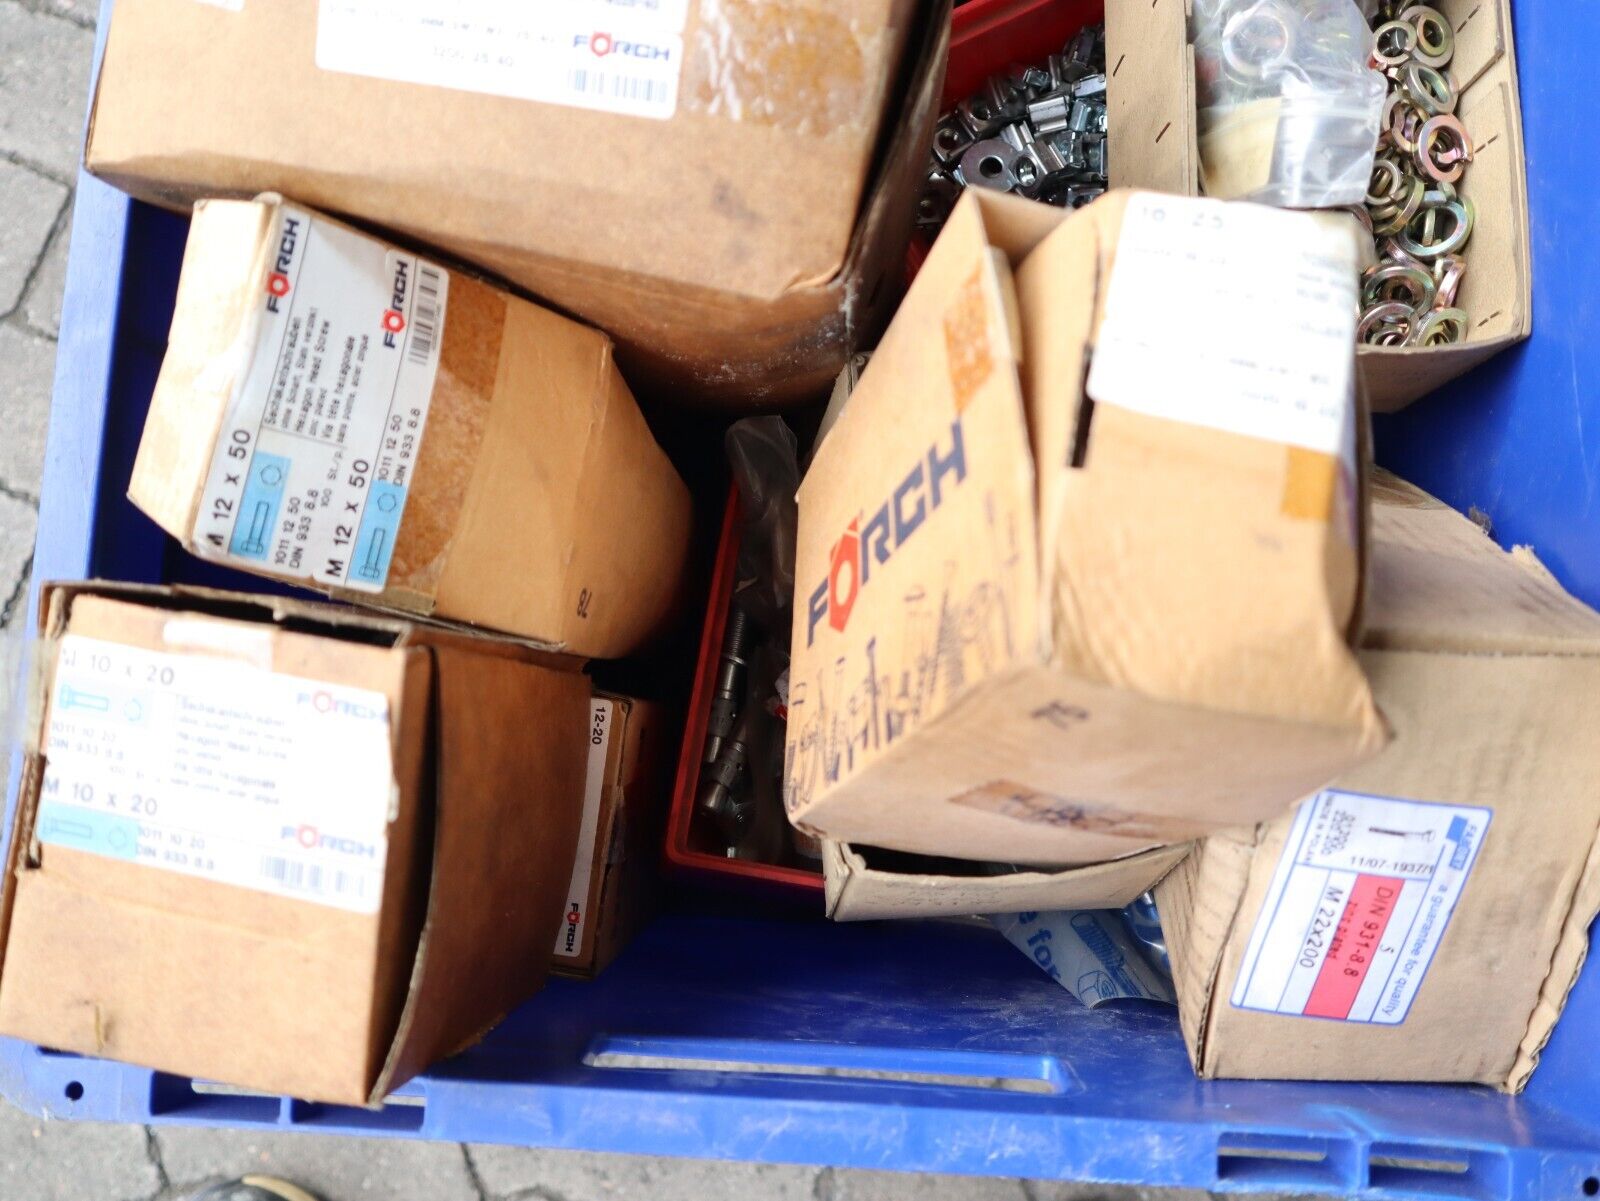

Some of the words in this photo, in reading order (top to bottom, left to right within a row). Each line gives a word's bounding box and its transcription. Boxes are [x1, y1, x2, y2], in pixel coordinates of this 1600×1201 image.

[390, 415, 402, 432] 50
[213, 498, 233, 519] 12
[228, 430, 251, 459] 50
[348, 460, 369, 488] 50
[287, 497, 301, 514] 50
[334, 525, 352, 545] 12
[326, 559, 343, 577] M
[591, 706, 605, 745] 12-20
[74, 783, 94, 802] 10
[131, 794, 158, 816] 20
[1325, 886, 1343, 902] M
[1369, 886, 1394, 917] DIN
[1300, 907, 1334, 968] 22x200
[1411, 896, 1442, 956] guarantee
[1344, 921, 1379, 977] 931-8.8
[1402, 959, 1420, 975] for
[1383, 977, 1407, 1015] quality
